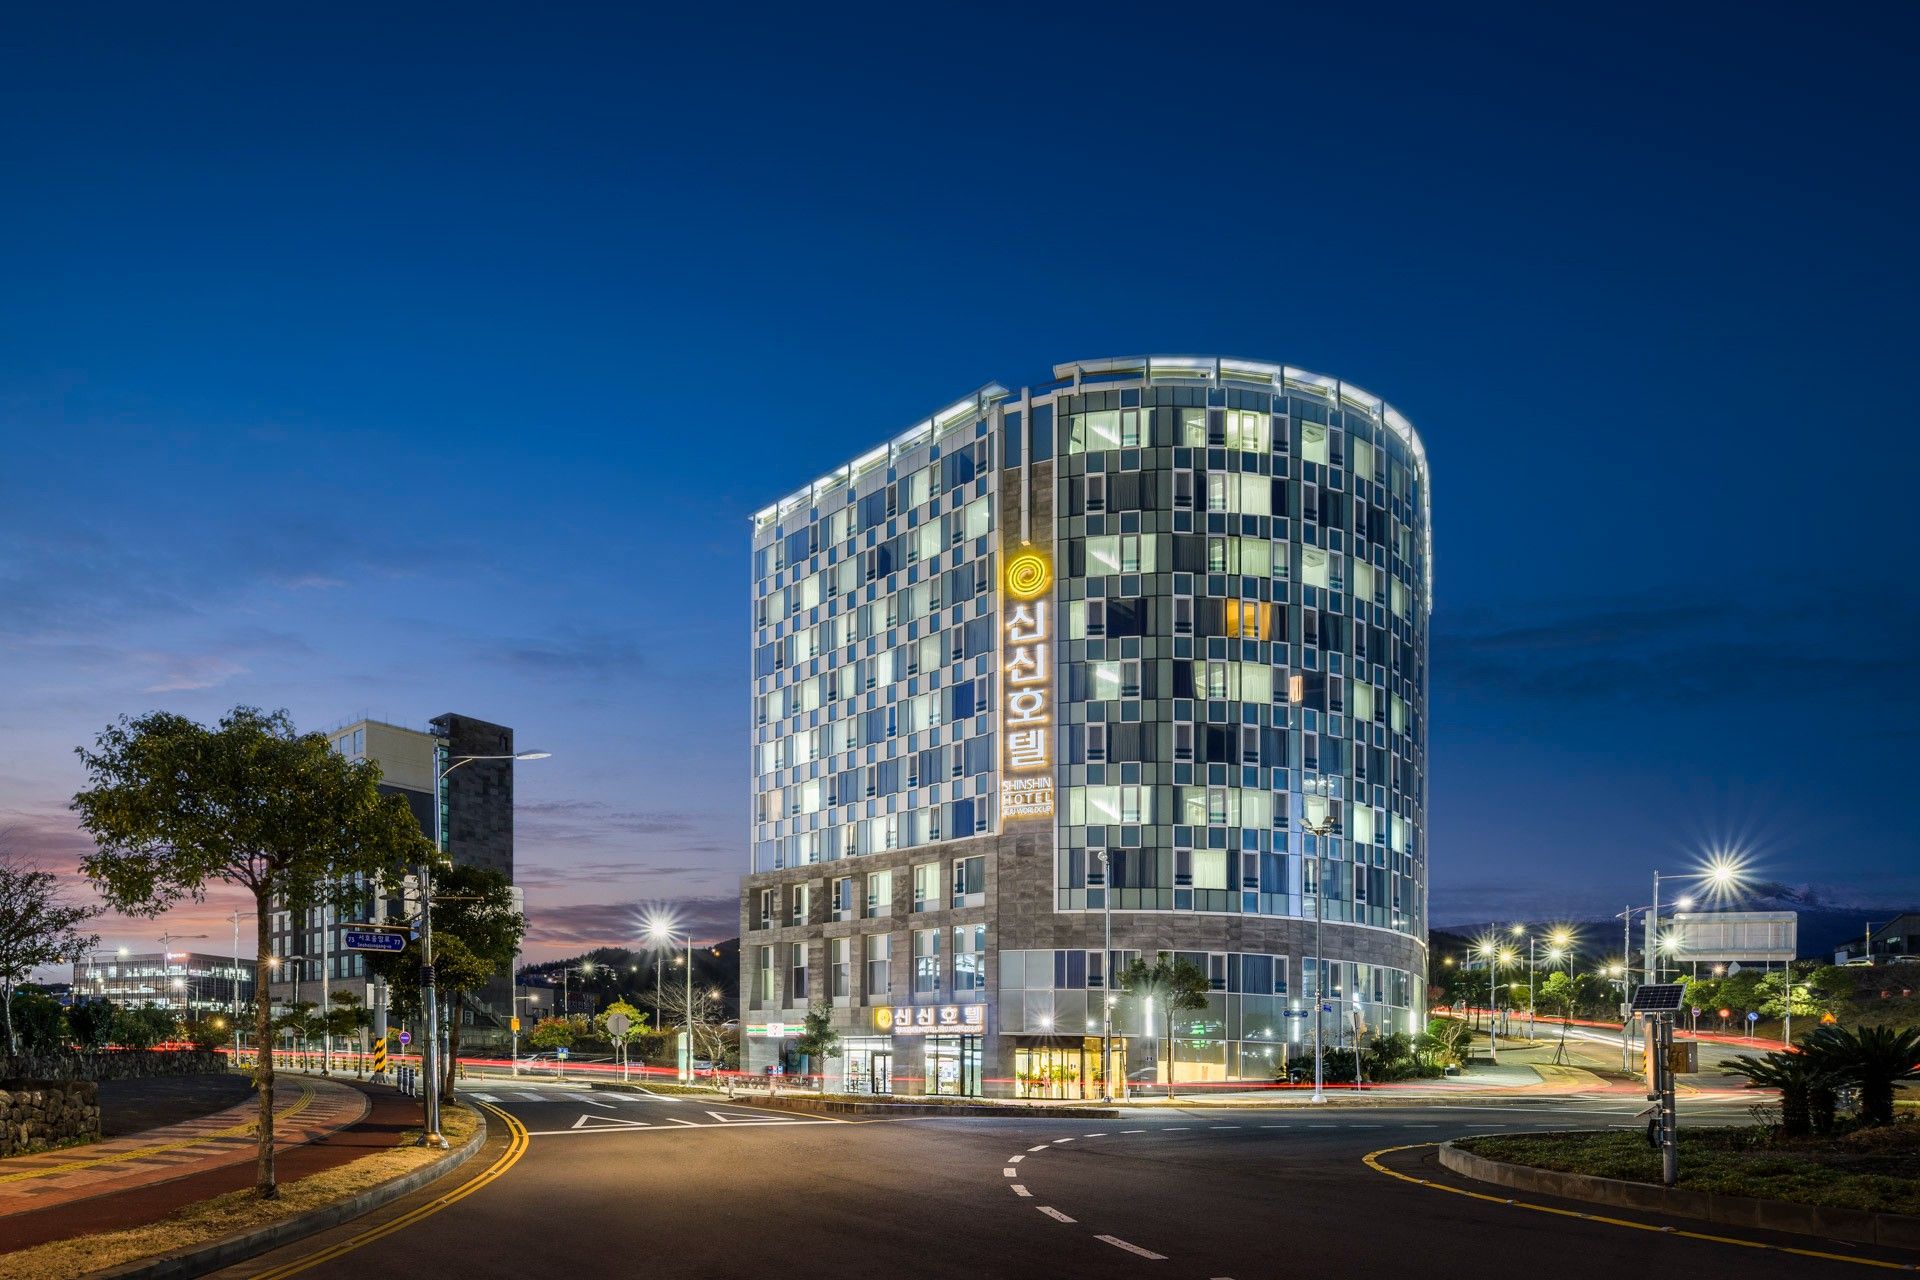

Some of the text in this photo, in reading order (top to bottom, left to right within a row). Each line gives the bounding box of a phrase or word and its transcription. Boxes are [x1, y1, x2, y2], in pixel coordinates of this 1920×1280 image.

[1006, 601, 1045, 767] 신신호텔
[1003, 777, 1051, 791] SHINSHIN
[1003, 792, 1052, 805] HOTEL
[894, 1006, 983, 1026] 신신호텔
